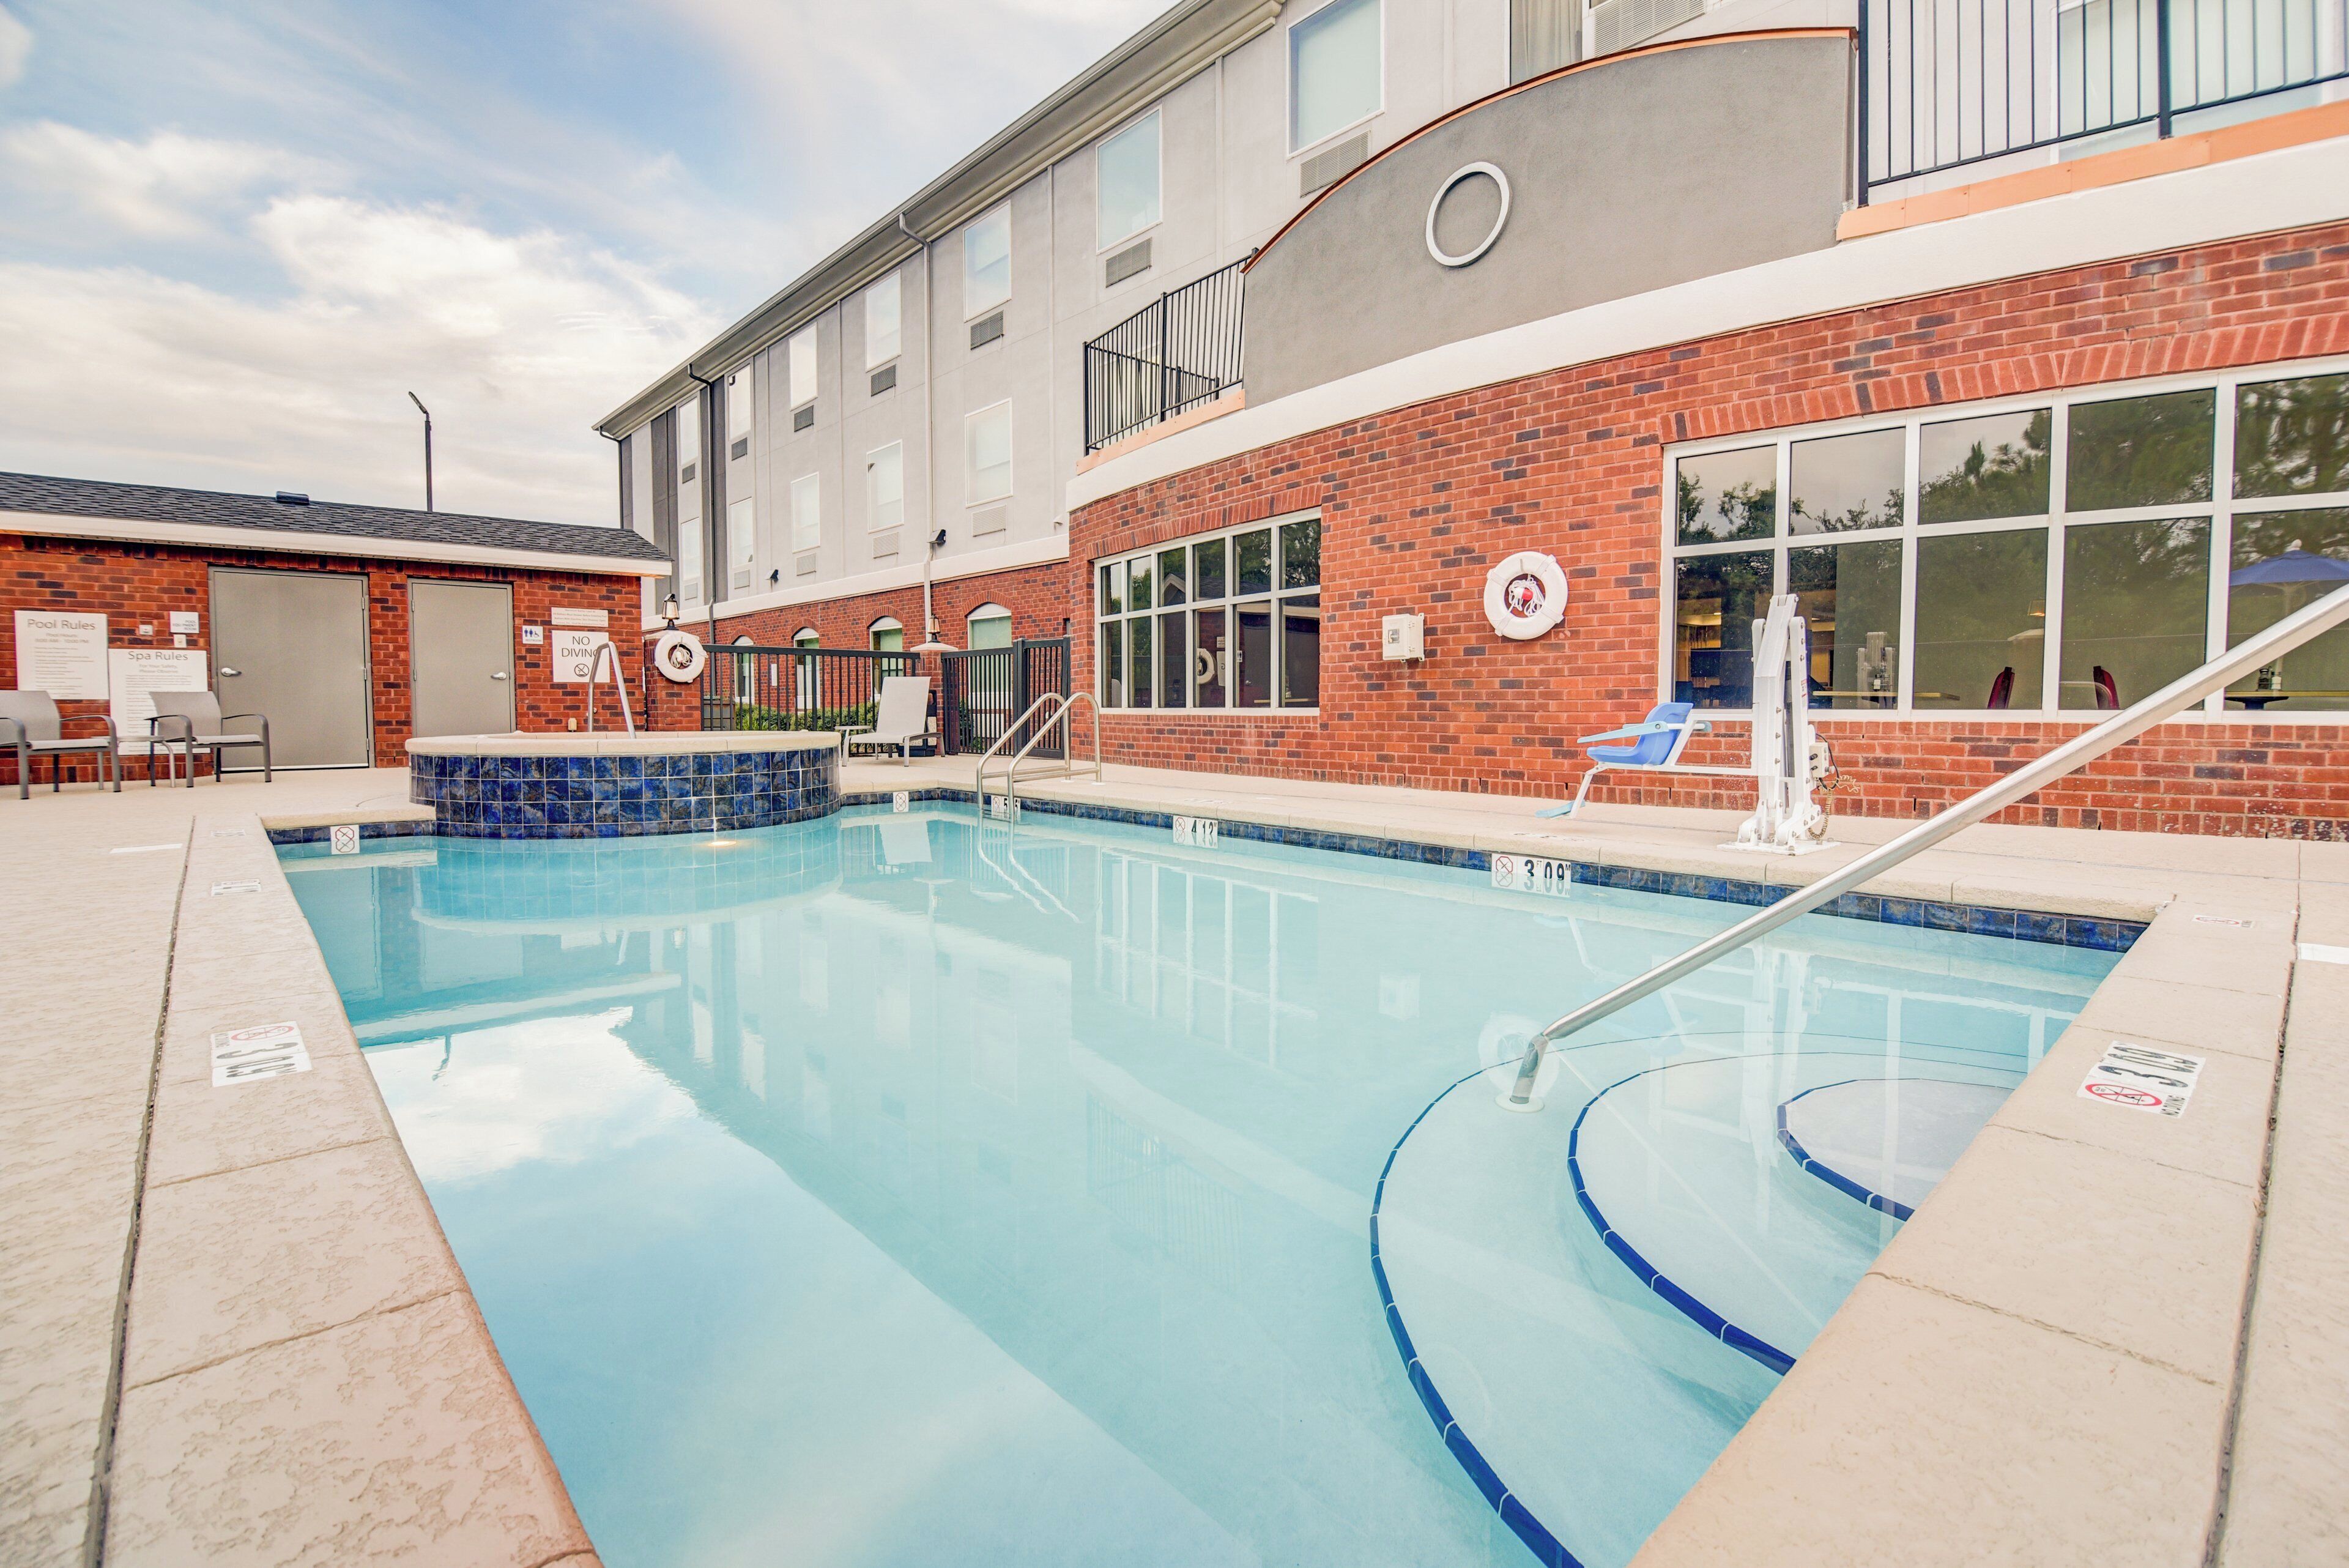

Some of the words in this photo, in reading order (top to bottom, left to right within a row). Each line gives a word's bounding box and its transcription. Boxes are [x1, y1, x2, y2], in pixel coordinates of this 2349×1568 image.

[28, 619, 56, 629] Pool
[61, 620, 96, 630] Rules
[572, 636, 590, 645] NO
[128, 650, 151, 661] Spa
[155, 651, 188, 661] Rules
[2098, 1065, 2189, 1088] 3
